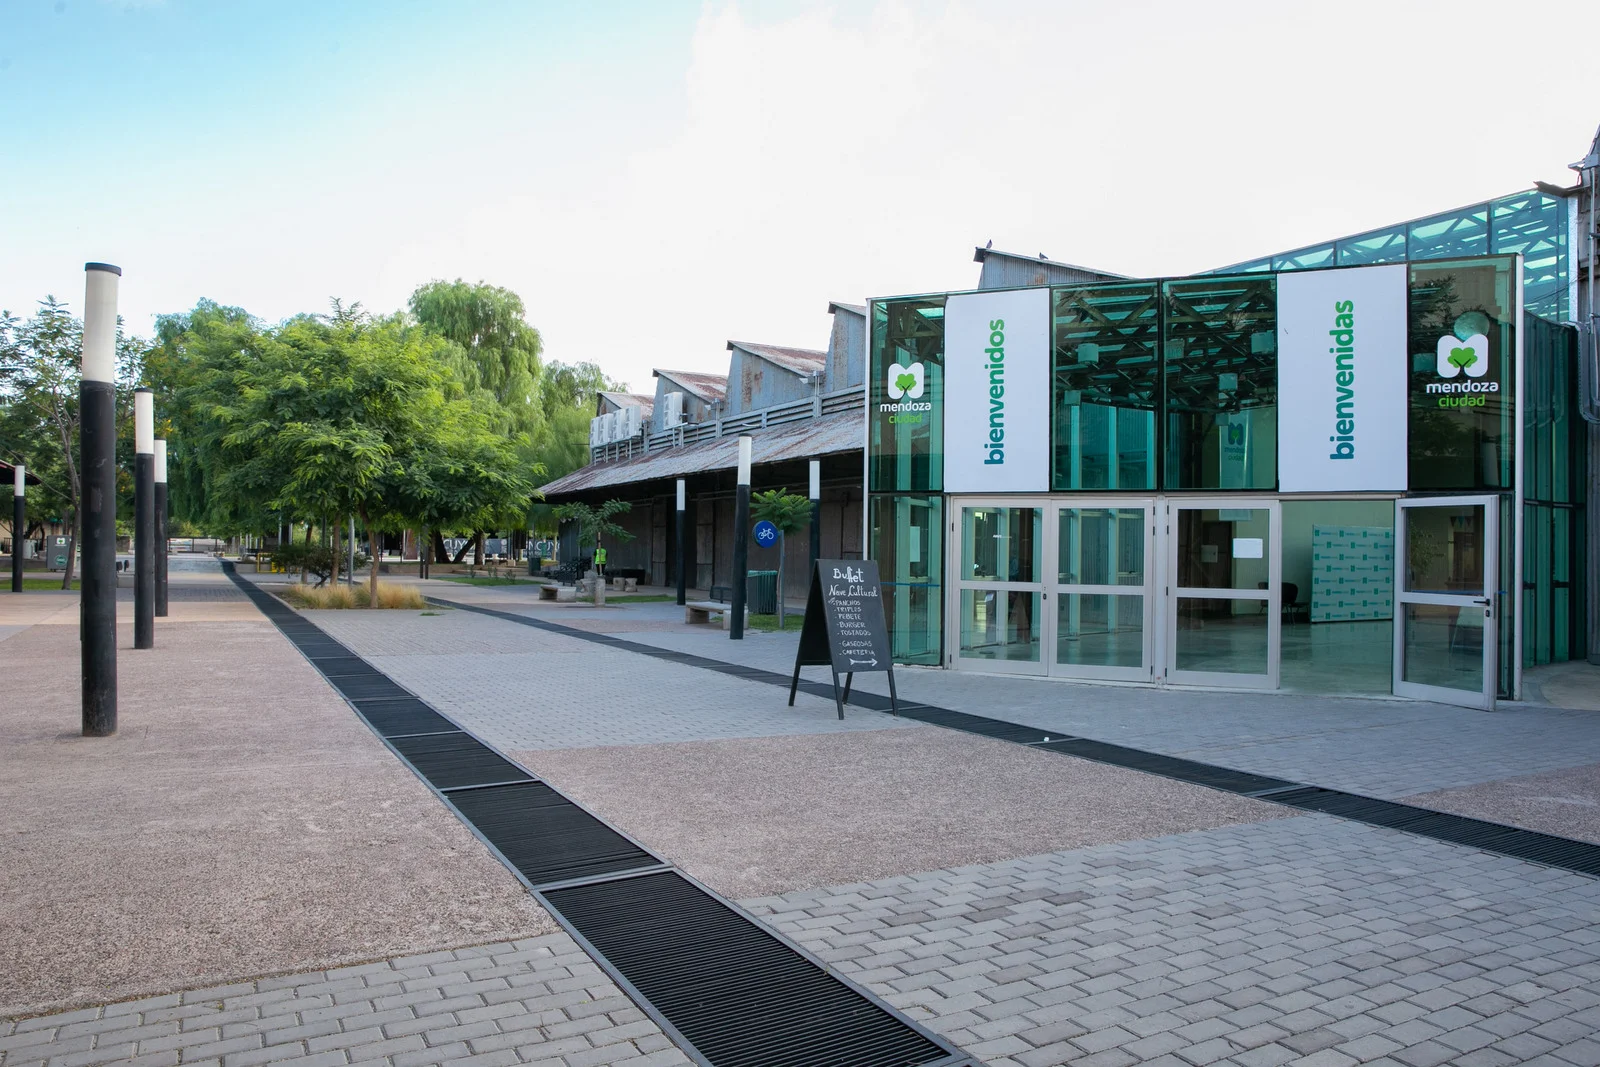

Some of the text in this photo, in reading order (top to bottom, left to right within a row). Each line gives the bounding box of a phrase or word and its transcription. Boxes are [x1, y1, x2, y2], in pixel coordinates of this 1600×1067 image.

[1329, 299, 1354, 459] bienvenidas
[984, 319, 1005, 465] bienvenidos
[1426, 379, 1499, 393] mendoza
[880, 400, 932, 412] mendoza
[1438, 394, 1486, 407] ciudad
[888, 413, 923, 424] ciudad
[833, 566, 864, 583] Buffet
[829, 584, 878, 597] Nave Cultural
